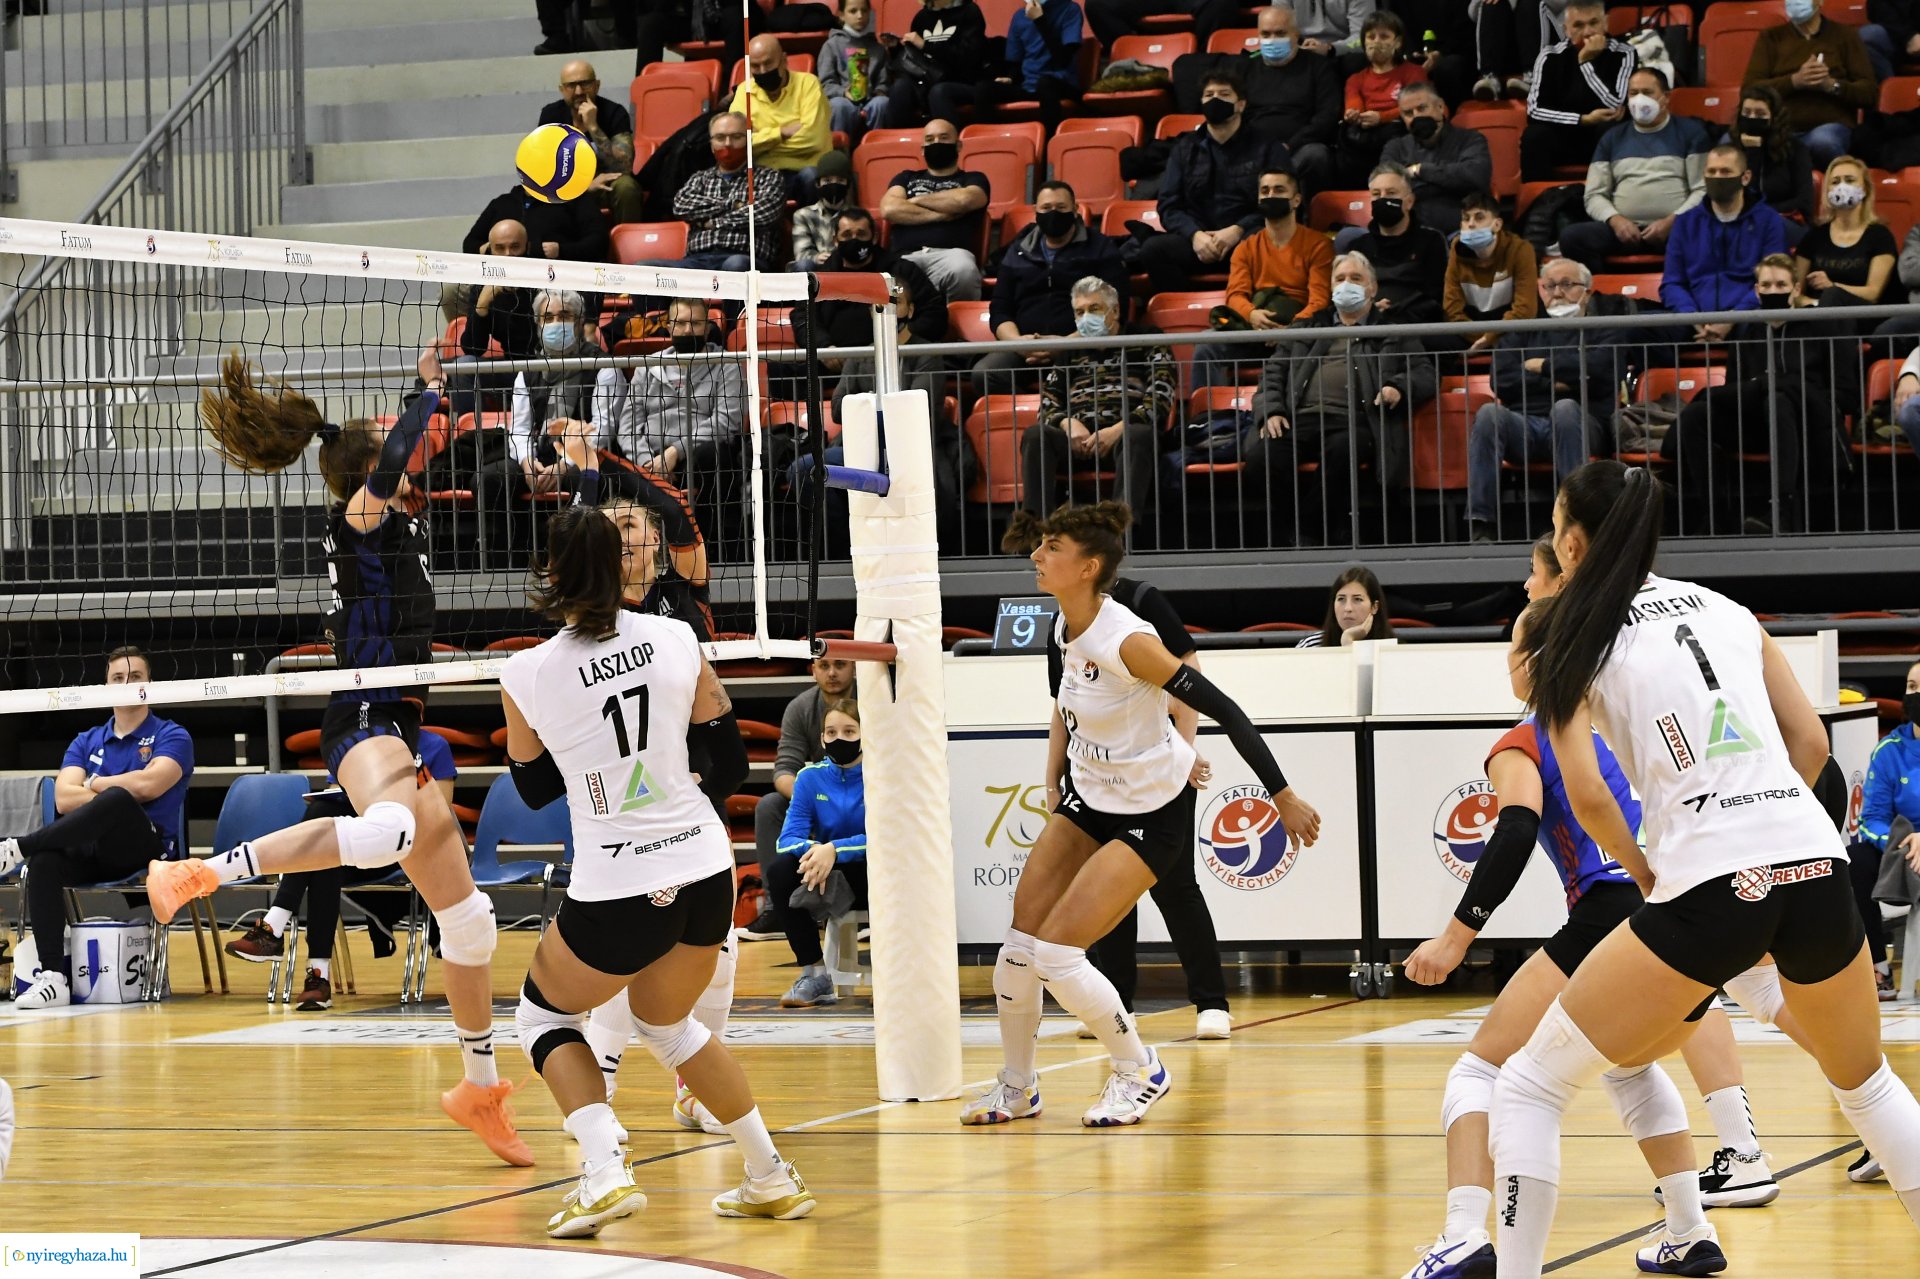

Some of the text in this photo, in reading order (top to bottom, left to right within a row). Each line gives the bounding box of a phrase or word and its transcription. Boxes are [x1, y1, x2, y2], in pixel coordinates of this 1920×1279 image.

[1001, 602, 1041, 614] Vasas
[1011, 615, 1036, 648] 9
[1674, 623, 1721, 691] 1
[602, 683, 650, 759] 17
[1661, 715, 1692, 769] STRABAG
[589, 772, 606, 815] STRABAG
[1222, 787, 1272, 803] FATUM
[1458, 782, 1496, 798] FATU
[1720, 787, 1800, 809] BESTRONG
[635, 825, 702, 855] BESTRONG
